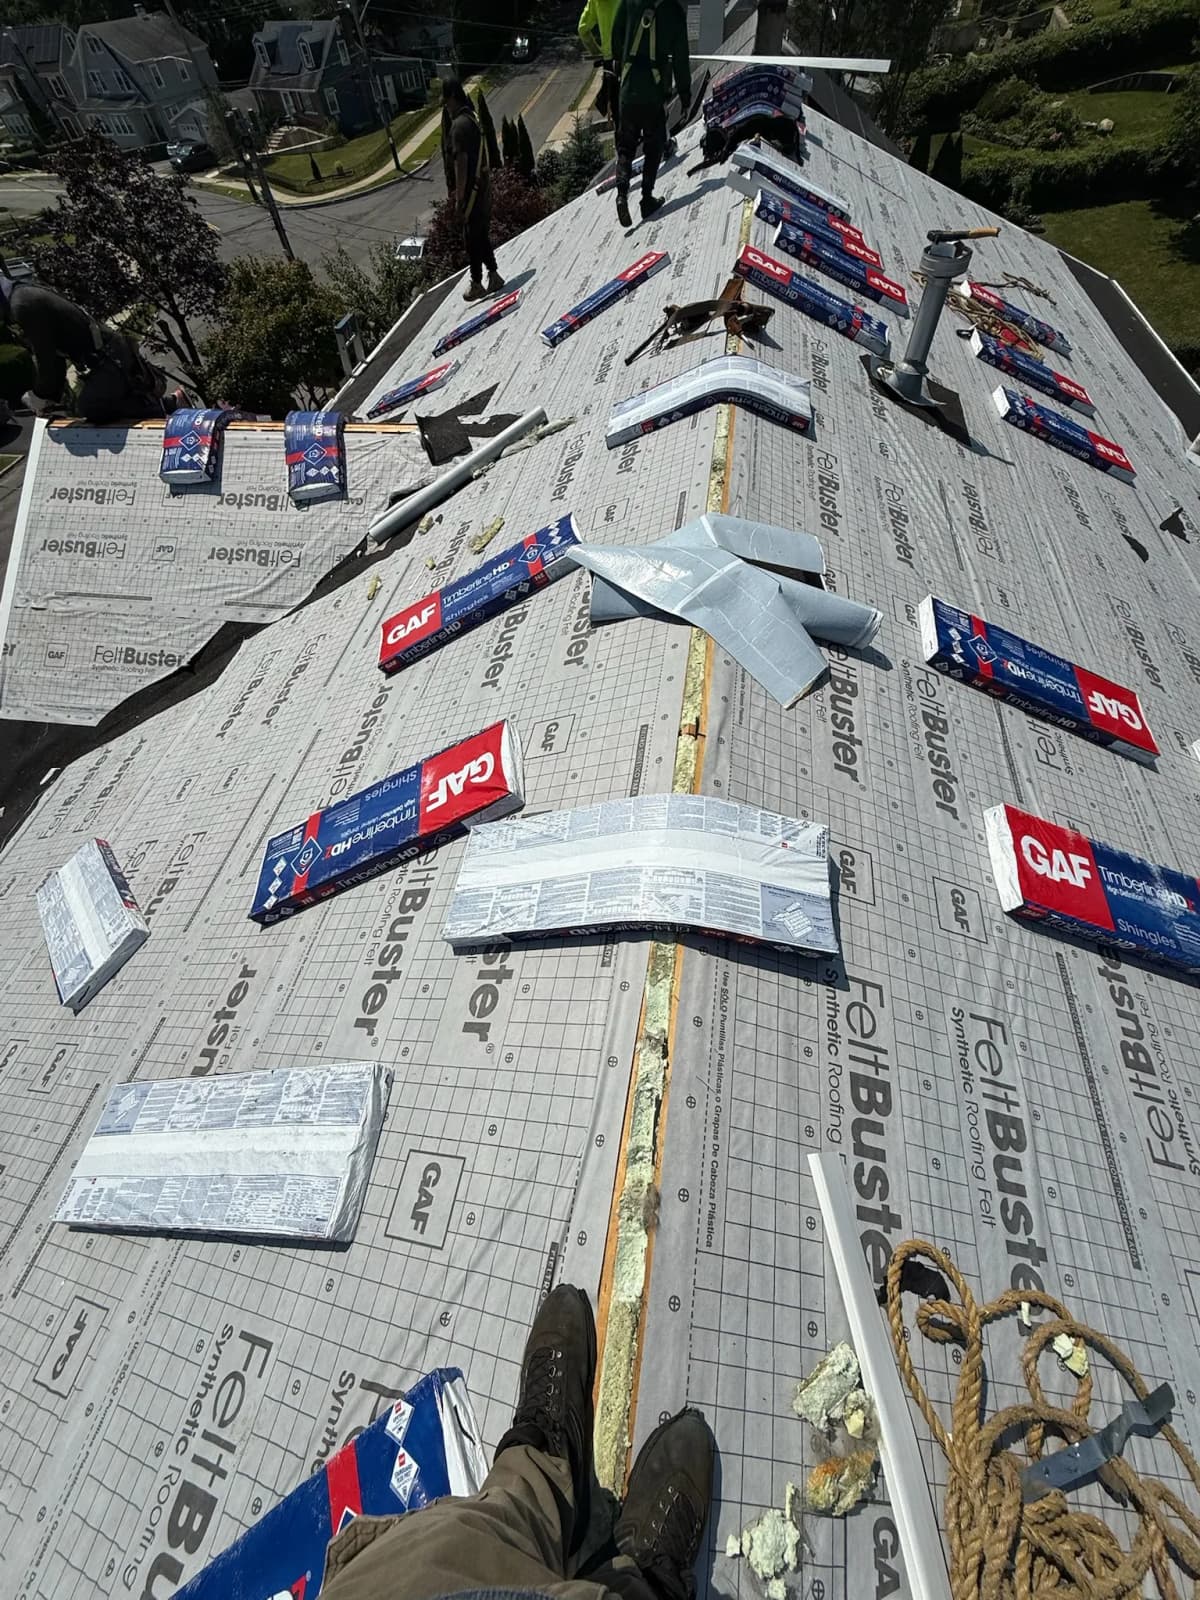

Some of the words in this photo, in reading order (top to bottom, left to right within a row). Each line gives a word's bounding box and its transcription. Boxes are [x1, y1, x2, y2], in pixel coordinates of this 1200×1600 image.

[747, 252, 788, 279] GAF
[869, 277, 902, 297] GAF
[49, 487, 136, 506] FeltBuster
[816, 448, 843, 538] FeltBuster
[40, 539, 127, 560] FeltBuster
[207, 546, 302, 568] FeltBuster
[386, 602, 437, 645] GAF
[216, 648, 282, 738] FeltBuster
[828, 643, 863, 783] eltBuster
[1088, 690, 1143, 731] GAF
[541, 721, 559, 751] GAF
[913, 664, 960, 821] FeltBuster
[364, 770, 418, 802] Shingles
[426, 751, 495, 813] GAF
[839, 850, 857, 894] GAF
[1020, 834, 1092, 889] GAF
[372, 887, 400, 939] Roofing
[950, 888, 970, 934] GAF
[1117, 918, 1177, 950] Shingles
[364, 942, 381, 966] Felt
[721, 971, 730, 988] Use
[825, 967, 840, 1057] Synthetic
[1135, 992, 1153, 1019] Felt
[1147, 1021, 1172, 1085] Roofing
[713, 1105, 722, 1143] Grapas
[825, 1061, 847, 1145] Roofing
[950, 1008, 974, 1094] Synthetic
[964, 1100, 988, 1181] Roofing
[976, 1188, 997, 1229] Felt
[712, 1144, 720, 1158] De
[845, 976, 902, 1285] FeltBuste
[411, 1162, 442, 1235] GAF
[52, 1308, 89, 1380] GAF
[176, 1322, 234, 1456] Synthetic
[123, 1463, 182, 1592] Roofing
[872, 1515, 902, 1600] GA
